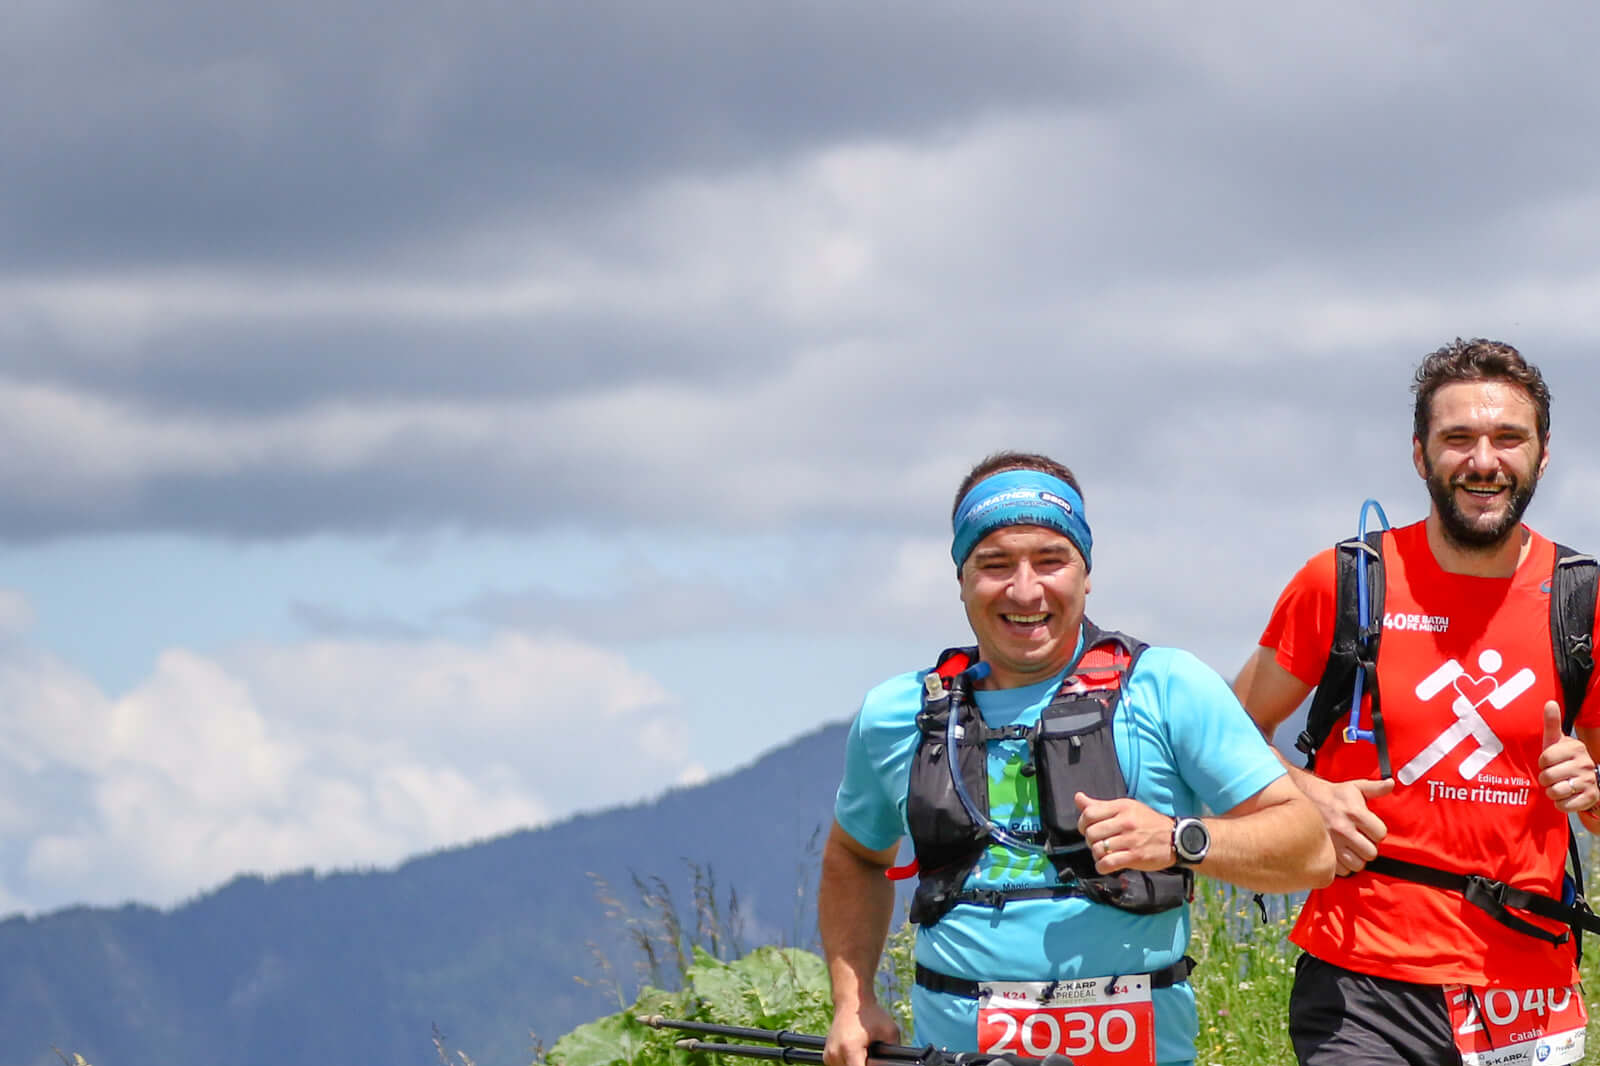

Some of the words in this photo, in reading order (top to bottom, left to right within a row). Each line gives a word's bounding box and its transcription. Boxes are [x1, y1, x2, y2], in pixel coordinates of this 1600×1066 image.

[1383, 612, 1407, 630] 40
[1407, 614, 1420, 623] DE
[1419, 623, 1449, 633] MINUT
[1003, 991, 1027, 1001] K24
[1055, 988, 1097, 1001] PREDEAL
[986, 1008, 1137, 1057] 2030
